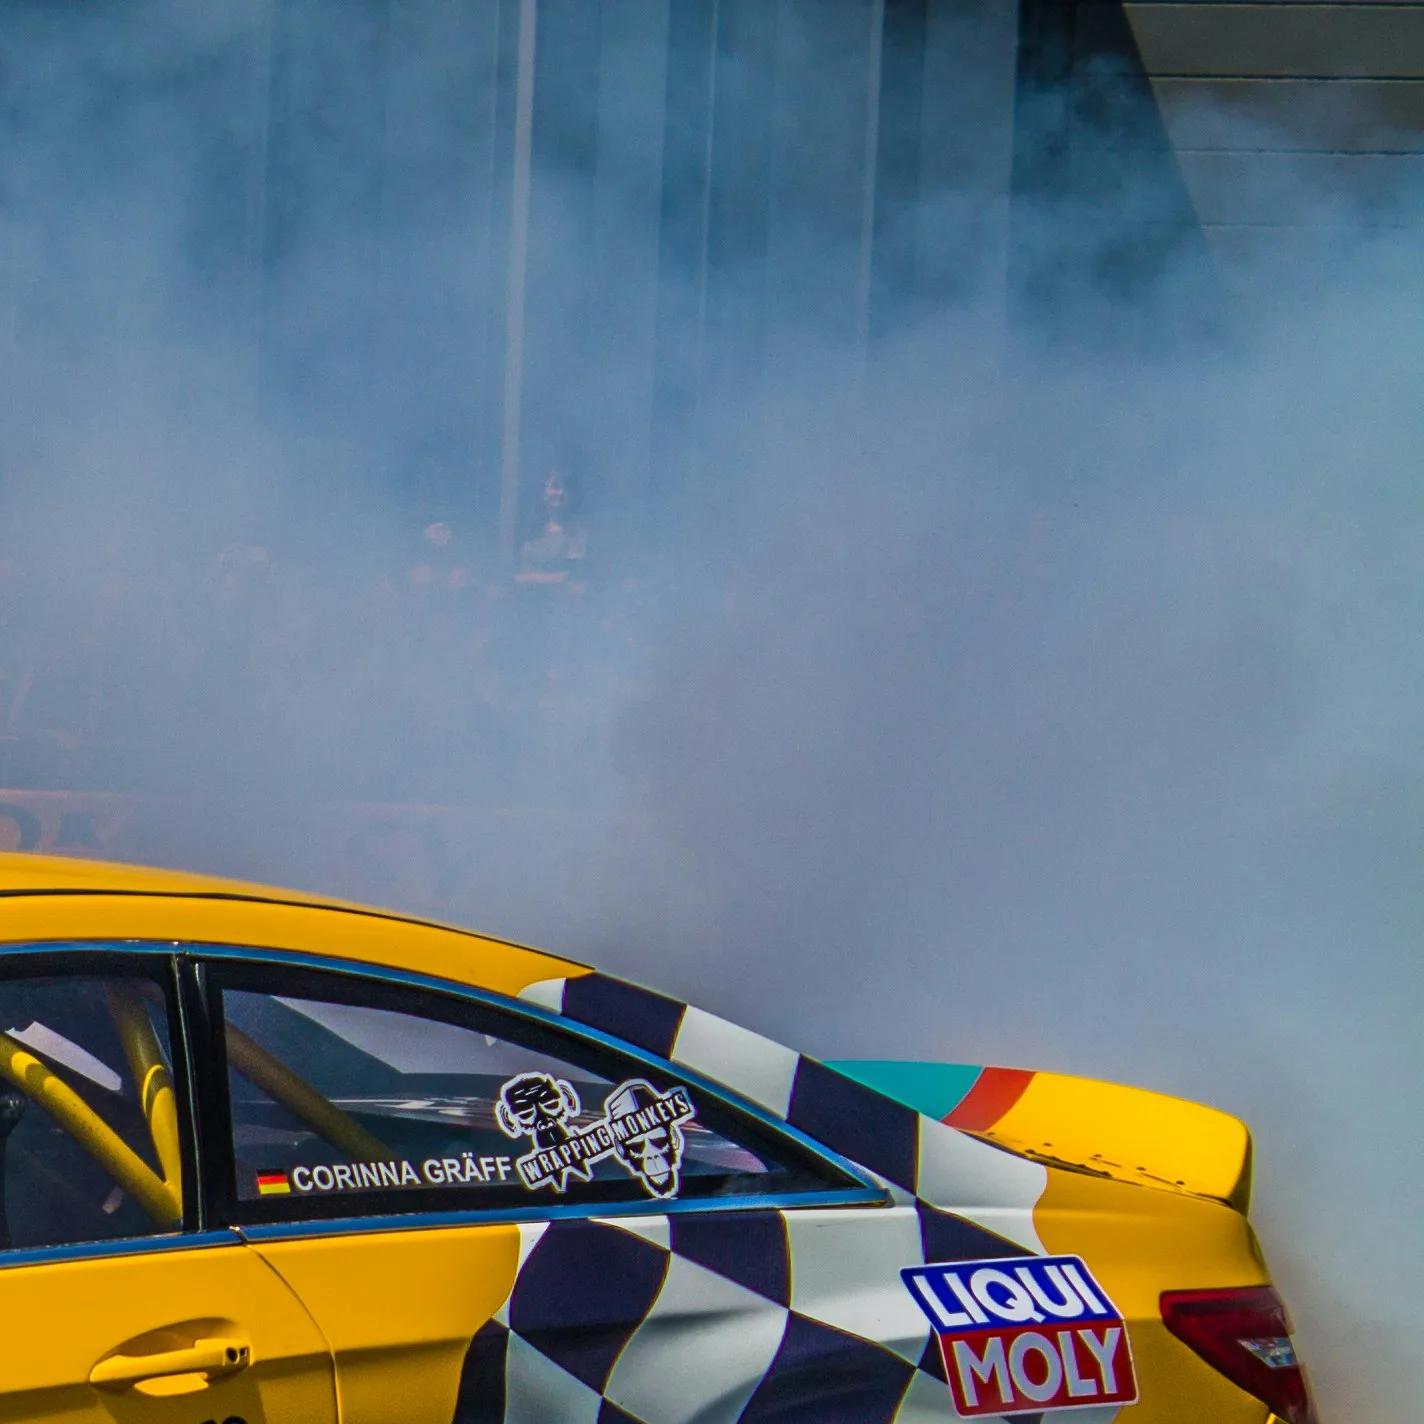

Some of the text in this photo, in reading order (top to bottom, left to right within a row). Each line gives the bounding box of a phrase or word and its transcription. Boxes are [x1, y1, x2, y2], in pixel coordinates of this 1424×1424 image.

[292, 1152, 512, 1192] CORINNA GRÄFF
[522, 1094, 690, 1183] WRAPPING MONKEYS
[911, 1263, 1109, 1329] LIQUI
[951, 1326, 1122, 1408] MOLY
